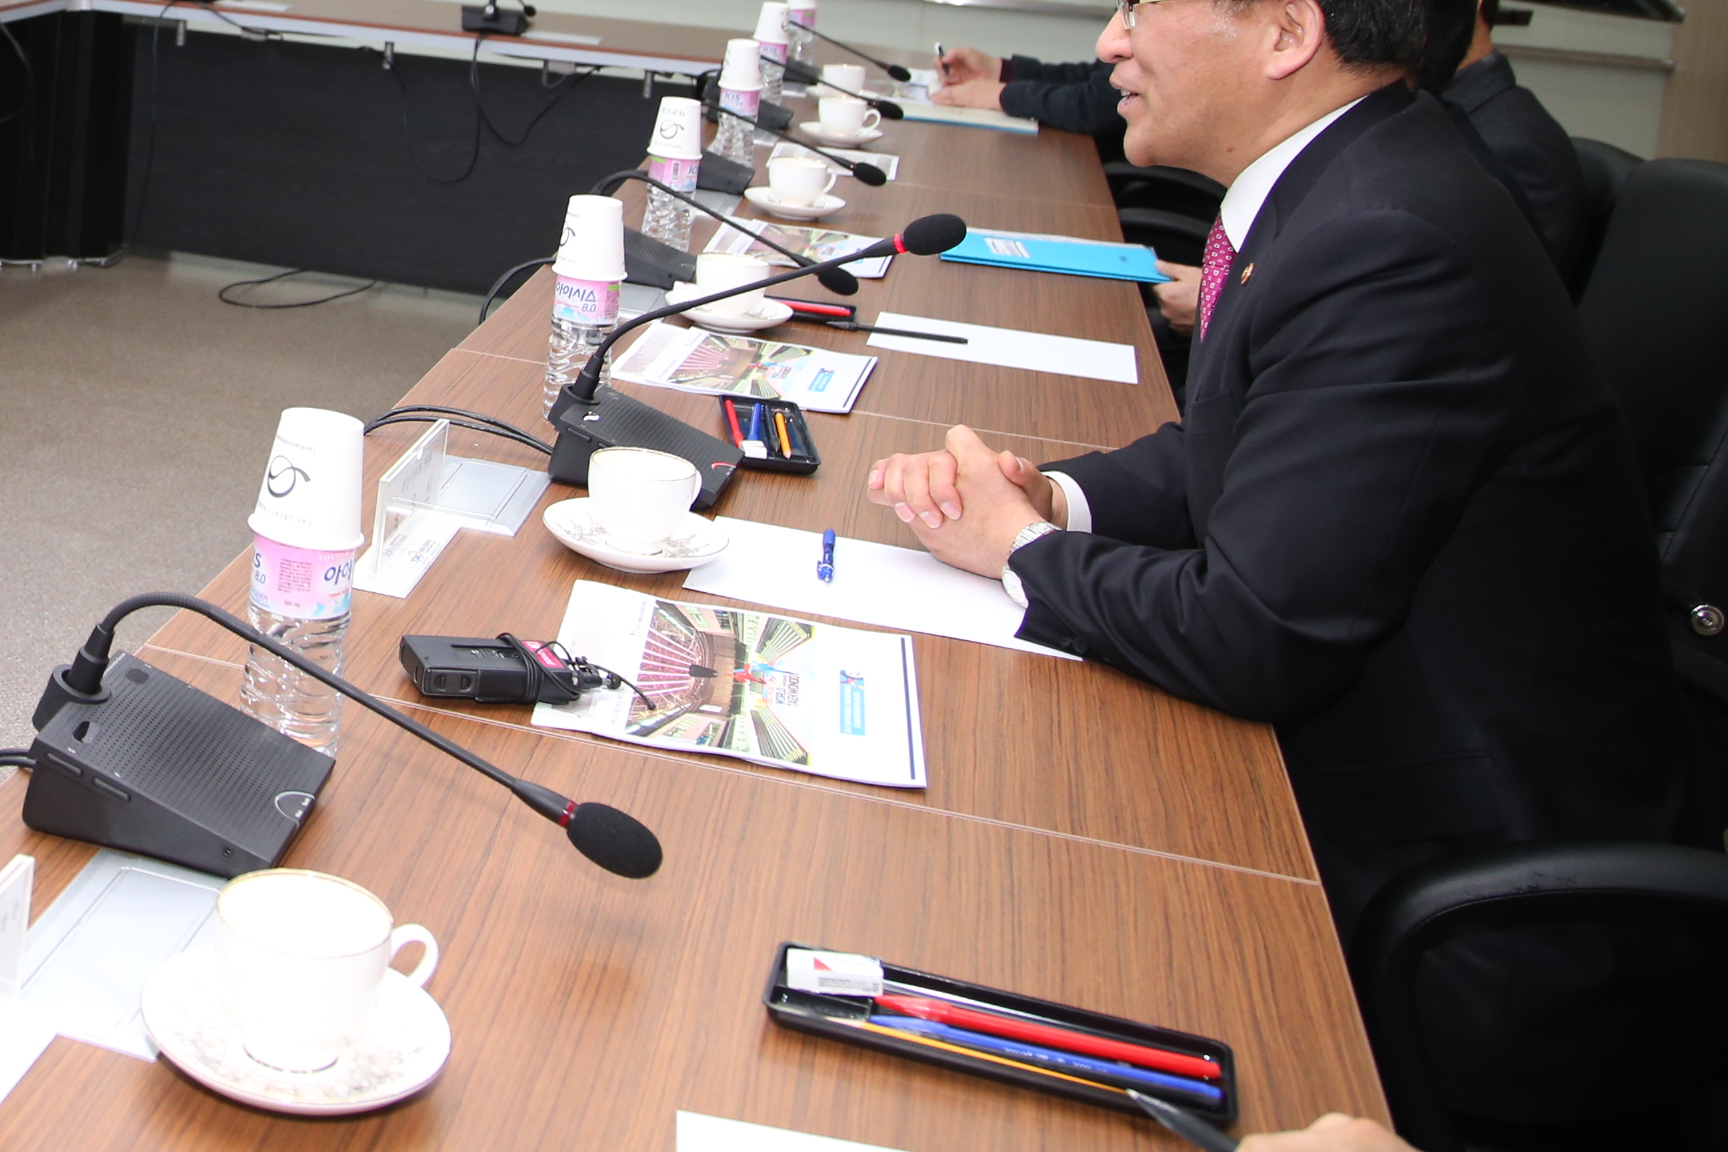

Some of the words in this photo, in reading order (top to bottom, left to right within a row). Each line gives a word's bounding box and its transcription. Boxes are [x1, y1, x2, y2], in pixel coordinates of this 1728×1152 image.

[555, 281, 598, 303] 아이시스
[581, 303, 598, 314] 8.0
[254, 570, 267, 585] 8.0
